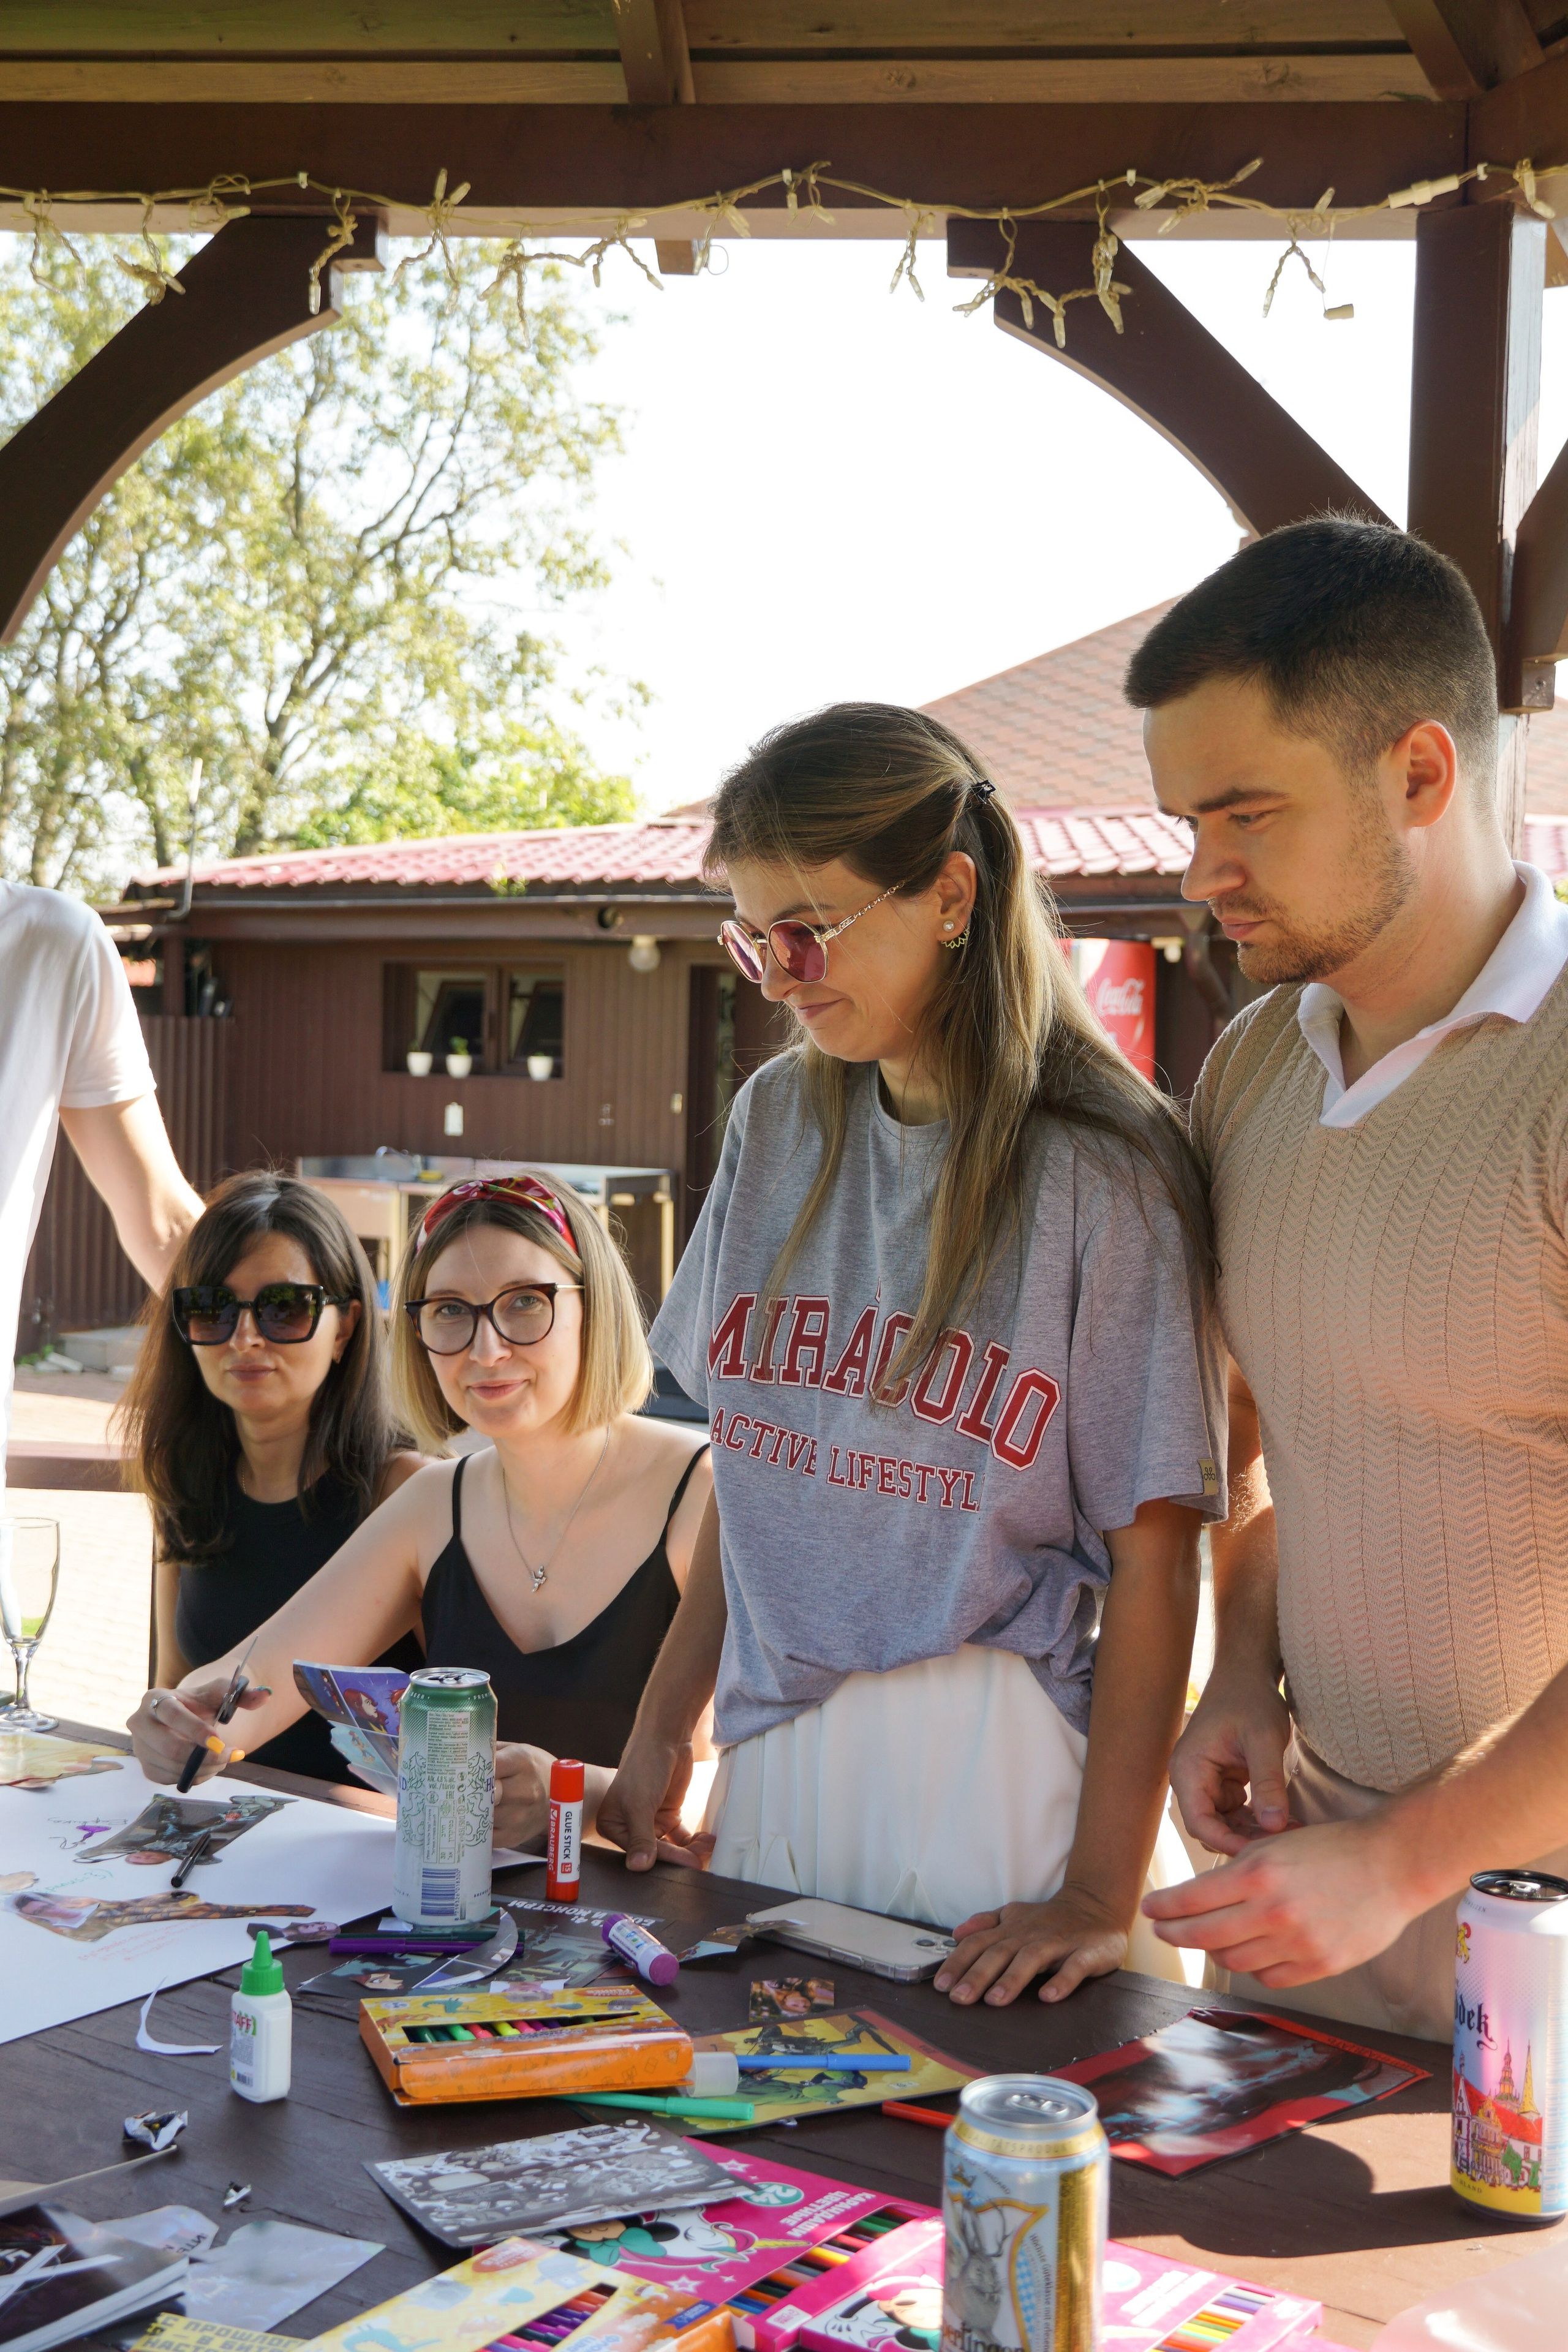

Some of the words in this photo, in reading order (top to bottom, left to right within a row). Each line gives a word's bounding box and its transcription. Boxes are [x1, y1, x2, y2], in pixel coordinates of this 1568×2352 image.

[710, 1406, 818, 1478] ACTIVE
[826, 1444, 987, 1514] LIFESTYL
[564, 1811, 573, 1833] GLUE
[507, 1899, 592, 1918] МОНСТРЫ
[750, 2184, 797, 2204] 24
[779, 2190, 850, 2226] ЦВЕТНЫЕ
[786, 2191, 878, 2237] КАРАНДАШИ
